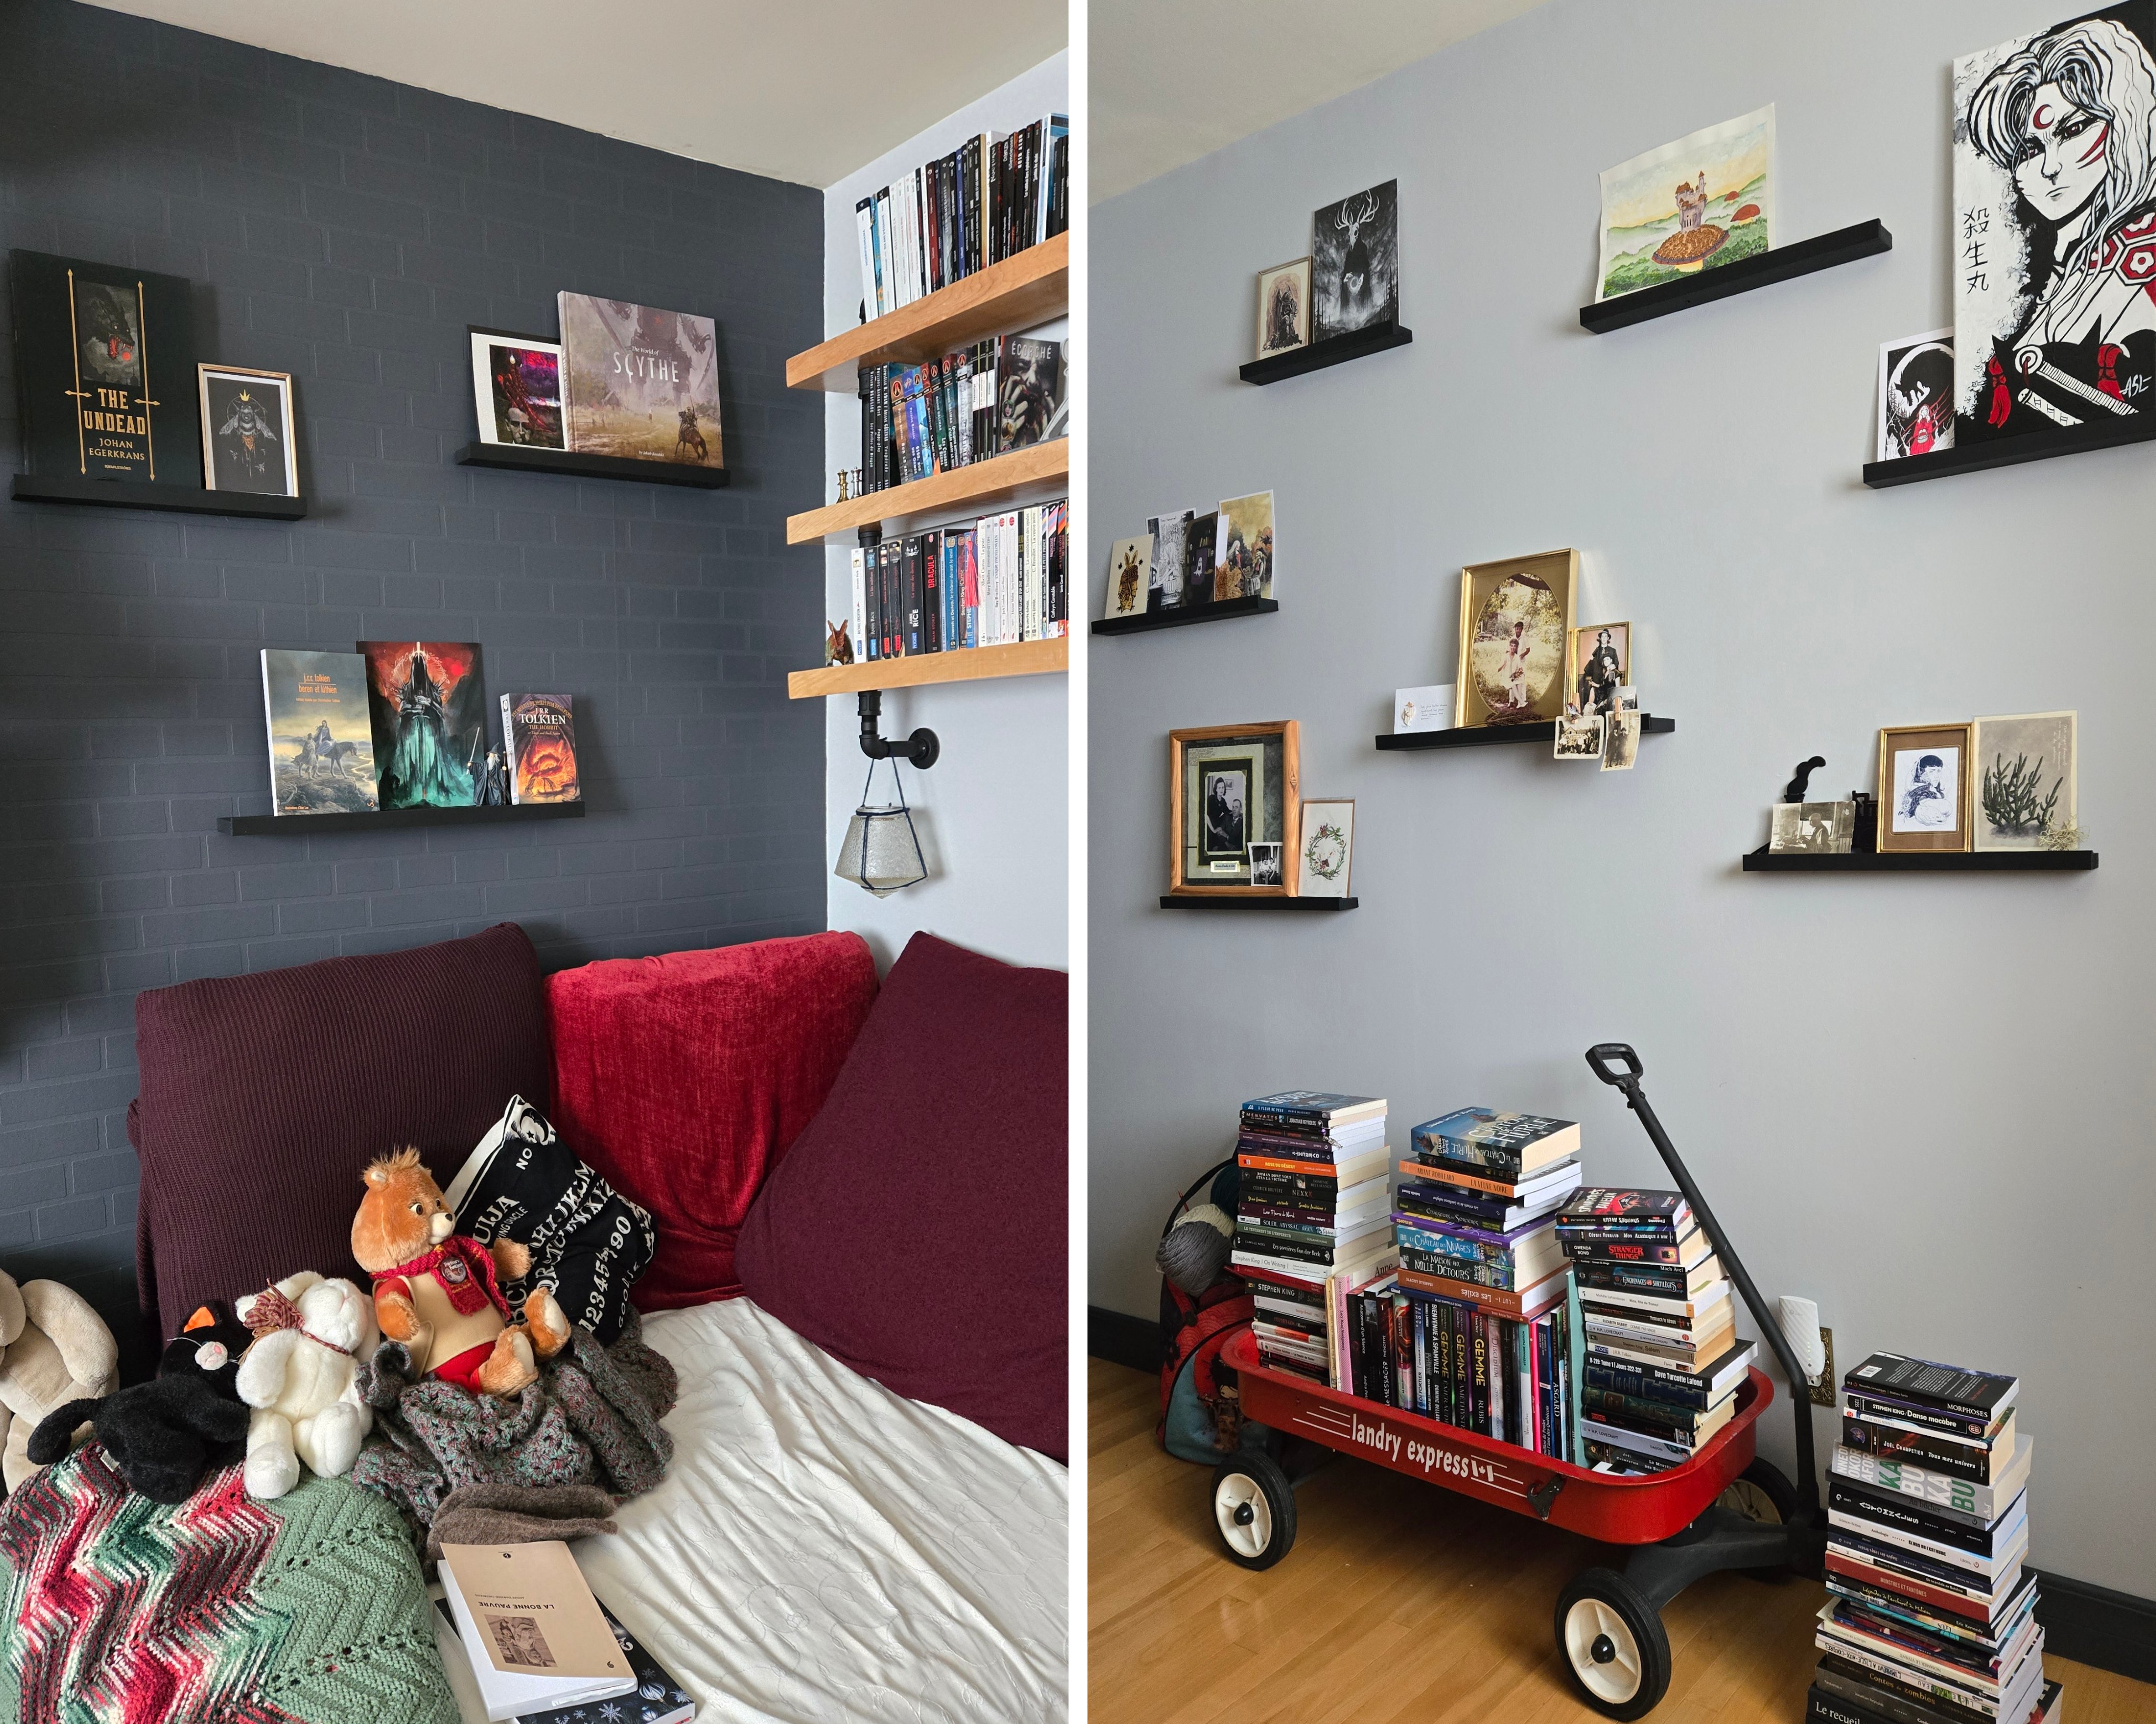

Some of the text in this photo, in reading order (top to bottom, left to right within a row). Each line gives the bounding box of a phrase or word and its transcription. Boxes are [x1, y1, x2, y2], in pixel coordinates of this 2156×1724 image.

[1961, 205, 1989, 295] 殺生丸
[1012, 340, 1052, 360] ÉCORCHÉ
[613, 352, 679, 384] SCYTHE
[98, 388, 128, 409] THE
[84, 410, 145, 435] UNDEAD
[99, 438, 133, 448] JOHAN
[89, 448, 145, 460] EGERKRANS
[315, 674, 331, 683] tolkien
[298, 684, 337, 694] beren et lúthien
[520, 714, 567, 724] TOLKIEN
[1246, 1112, 1277, 1120] MENVATTS
[1489, 1118, 1558, 1143] HURLE
[516, 1148, 532, 1170] NO
[1451, 1142, 1505, 1164] CHÂTEAU HURLE
[1417, 1167, 1432, 1176] ARIANE
[1432, 1170, 1455, 1181] ROBILLARD
[1478, 1180, 1492, 1190] VEUVE
[1493, 1183, 1508, 1194] NOIRE
[1293, 1189, 1312, 1198] NEXXX
[1595, 1192, 1617, 1210] AVEUX
[473, 1196, 520, 1244] UIJA
[1280, 1221, 1299, 1230] ABYSSAL
[1279, 1245, 1296, 1254] sorcières
[1414, 1235, 1471, 1254] CHÂTEAU NUAGES
[1609, 1244, 1644, 1257] STRANGER
[1271, 1260, 1286, 1269] Writing
[1430, 1255, 1451, 1266] MAISON
[1375, 1263, 1393, 1277] Anne
[1414, 1259, 1470, 1280] MILLE DÉTOURS
[1258, 1284, 1281, 1294] STEPHEN
[1620, 1276, 1677, 1292] ENGRENAGES SORTILÈGES
[1461, 1289, 1479, 1299] exilés
[1481, 1294, 1491, 1302] Les
[1441, 1331, 1449, 1379] GEMME
[1456, 1334, 1466, 1381] GEMME
[1595, 1345, 1609, 1354] POCKET
[1644, 1346, 1660, 1354] Salem
[1474, 1338, 1485, 1387] GEMME
[1615, 1362, 1627, 1370] Jours
[1627, 1365, 1642, 1374] 322-331
[1655, 1370, 1666, 1379] Dave
[1666, 1371, 1686, 1384] Turcotte
[1686, 1376, 1703, 1387] Lafond
[1873, 1404, 1957, 1428] STEPHEN macabre
[1947, 1402, 1988, 1418] MORPHOSES
[1599, 1431, 1619, 1440] LOVECRAFT
[1352, 1413, 1469, 1478] landry express
[1883, 1440, 1895, 1449] JOËL
[1896, 1444, 1924, 1456] CHAMPETIER
[1928, 1451, 1940, 1460] Tous
[1954, 1459, 1976, 1469] univers
[1859, 1501, 1919, 1525] AUTOMNALES
[1871, 1528, 1889, 1538] Anthologie
[1880, 1577, 1901, 1590] MONSTRES
[1907, 1585, 1928, 1598] FANTÔMES
[1930, 1579, 1946, 1588] scandale
[1950, 1585, 1963, 1593] Bohême
[1965, 1623, 1984, 1635] Kennedy
[1869, 1672, 1894, 1688] Contes
[1816, 1701, 1861, 1724] Le recueil
